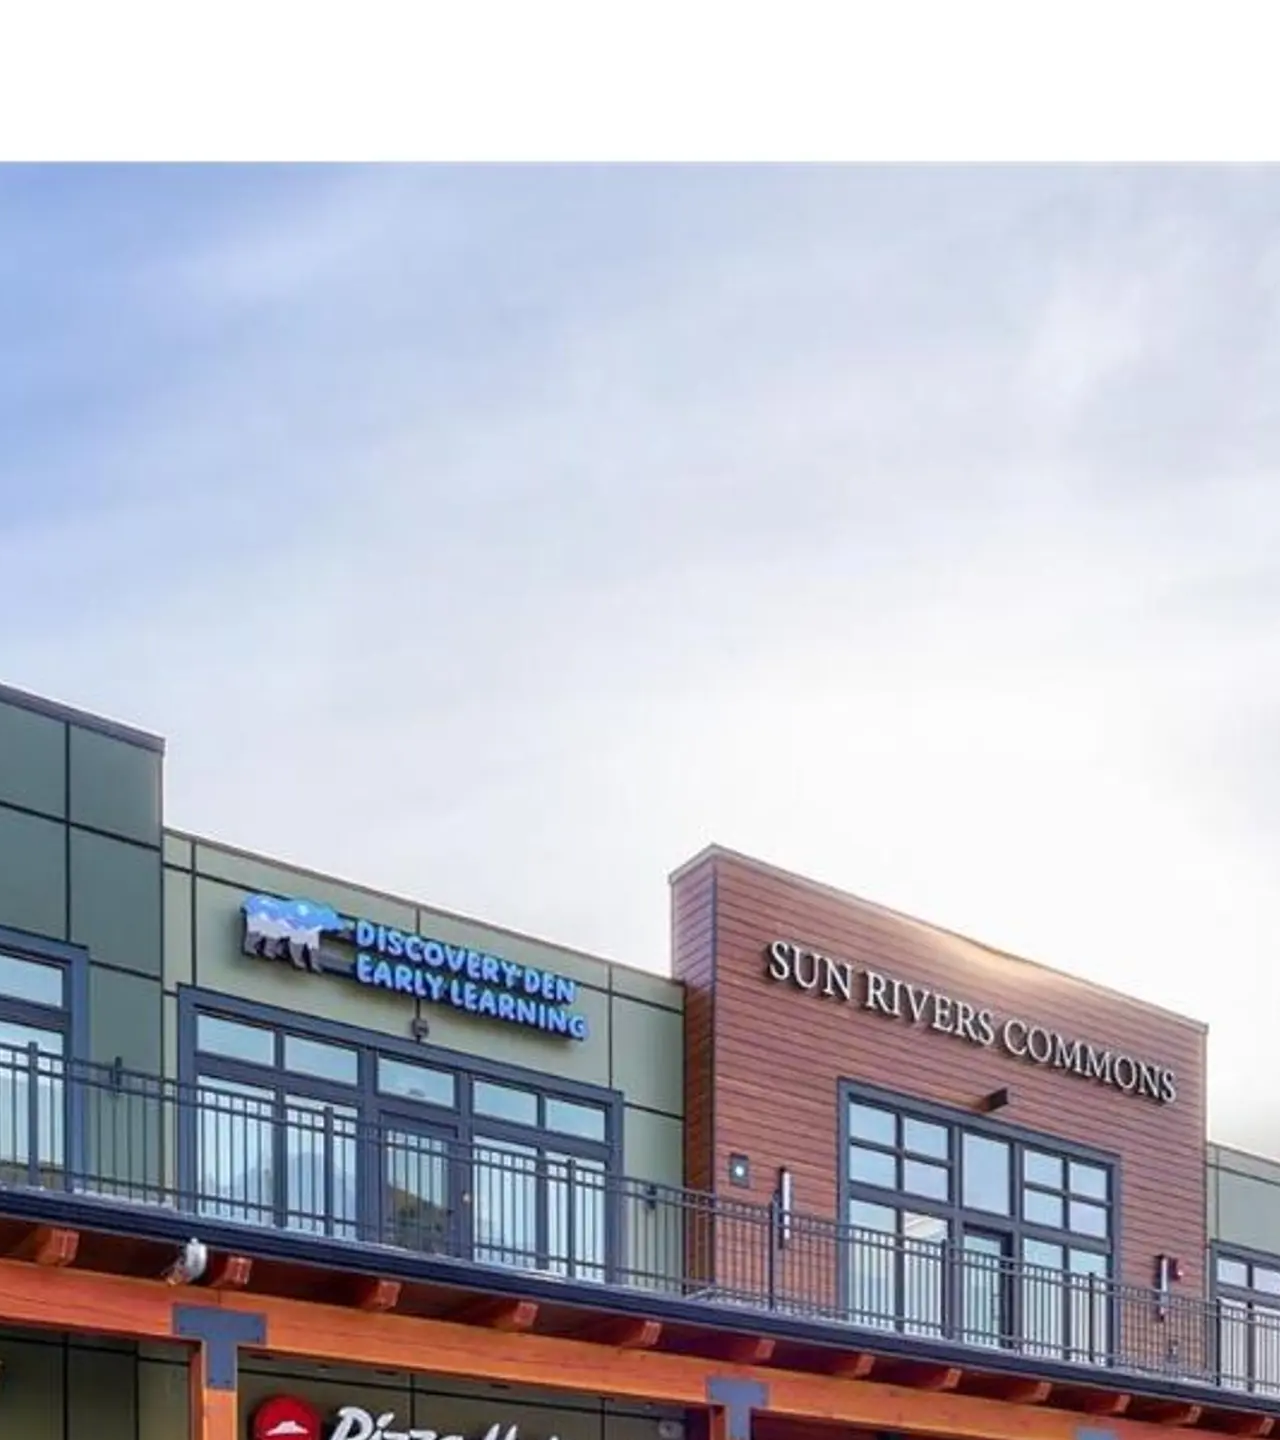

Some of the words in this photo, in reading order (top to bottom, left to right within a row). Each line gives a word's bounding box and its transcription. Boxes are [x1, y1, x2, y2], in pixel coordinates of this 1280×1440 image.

[356, 919, 522, 987] DISCOVERY
[523, 966, 576, 1003] DEN
[357, 953, 446, 1001] EARLY
[449, 978, 588, 1039] LEARNING
[770, 940, 852, 1001] SUN
[866, 970, 995, 1046] RIVERS
[1003, 1018, 1177, 1103] COMMONS
